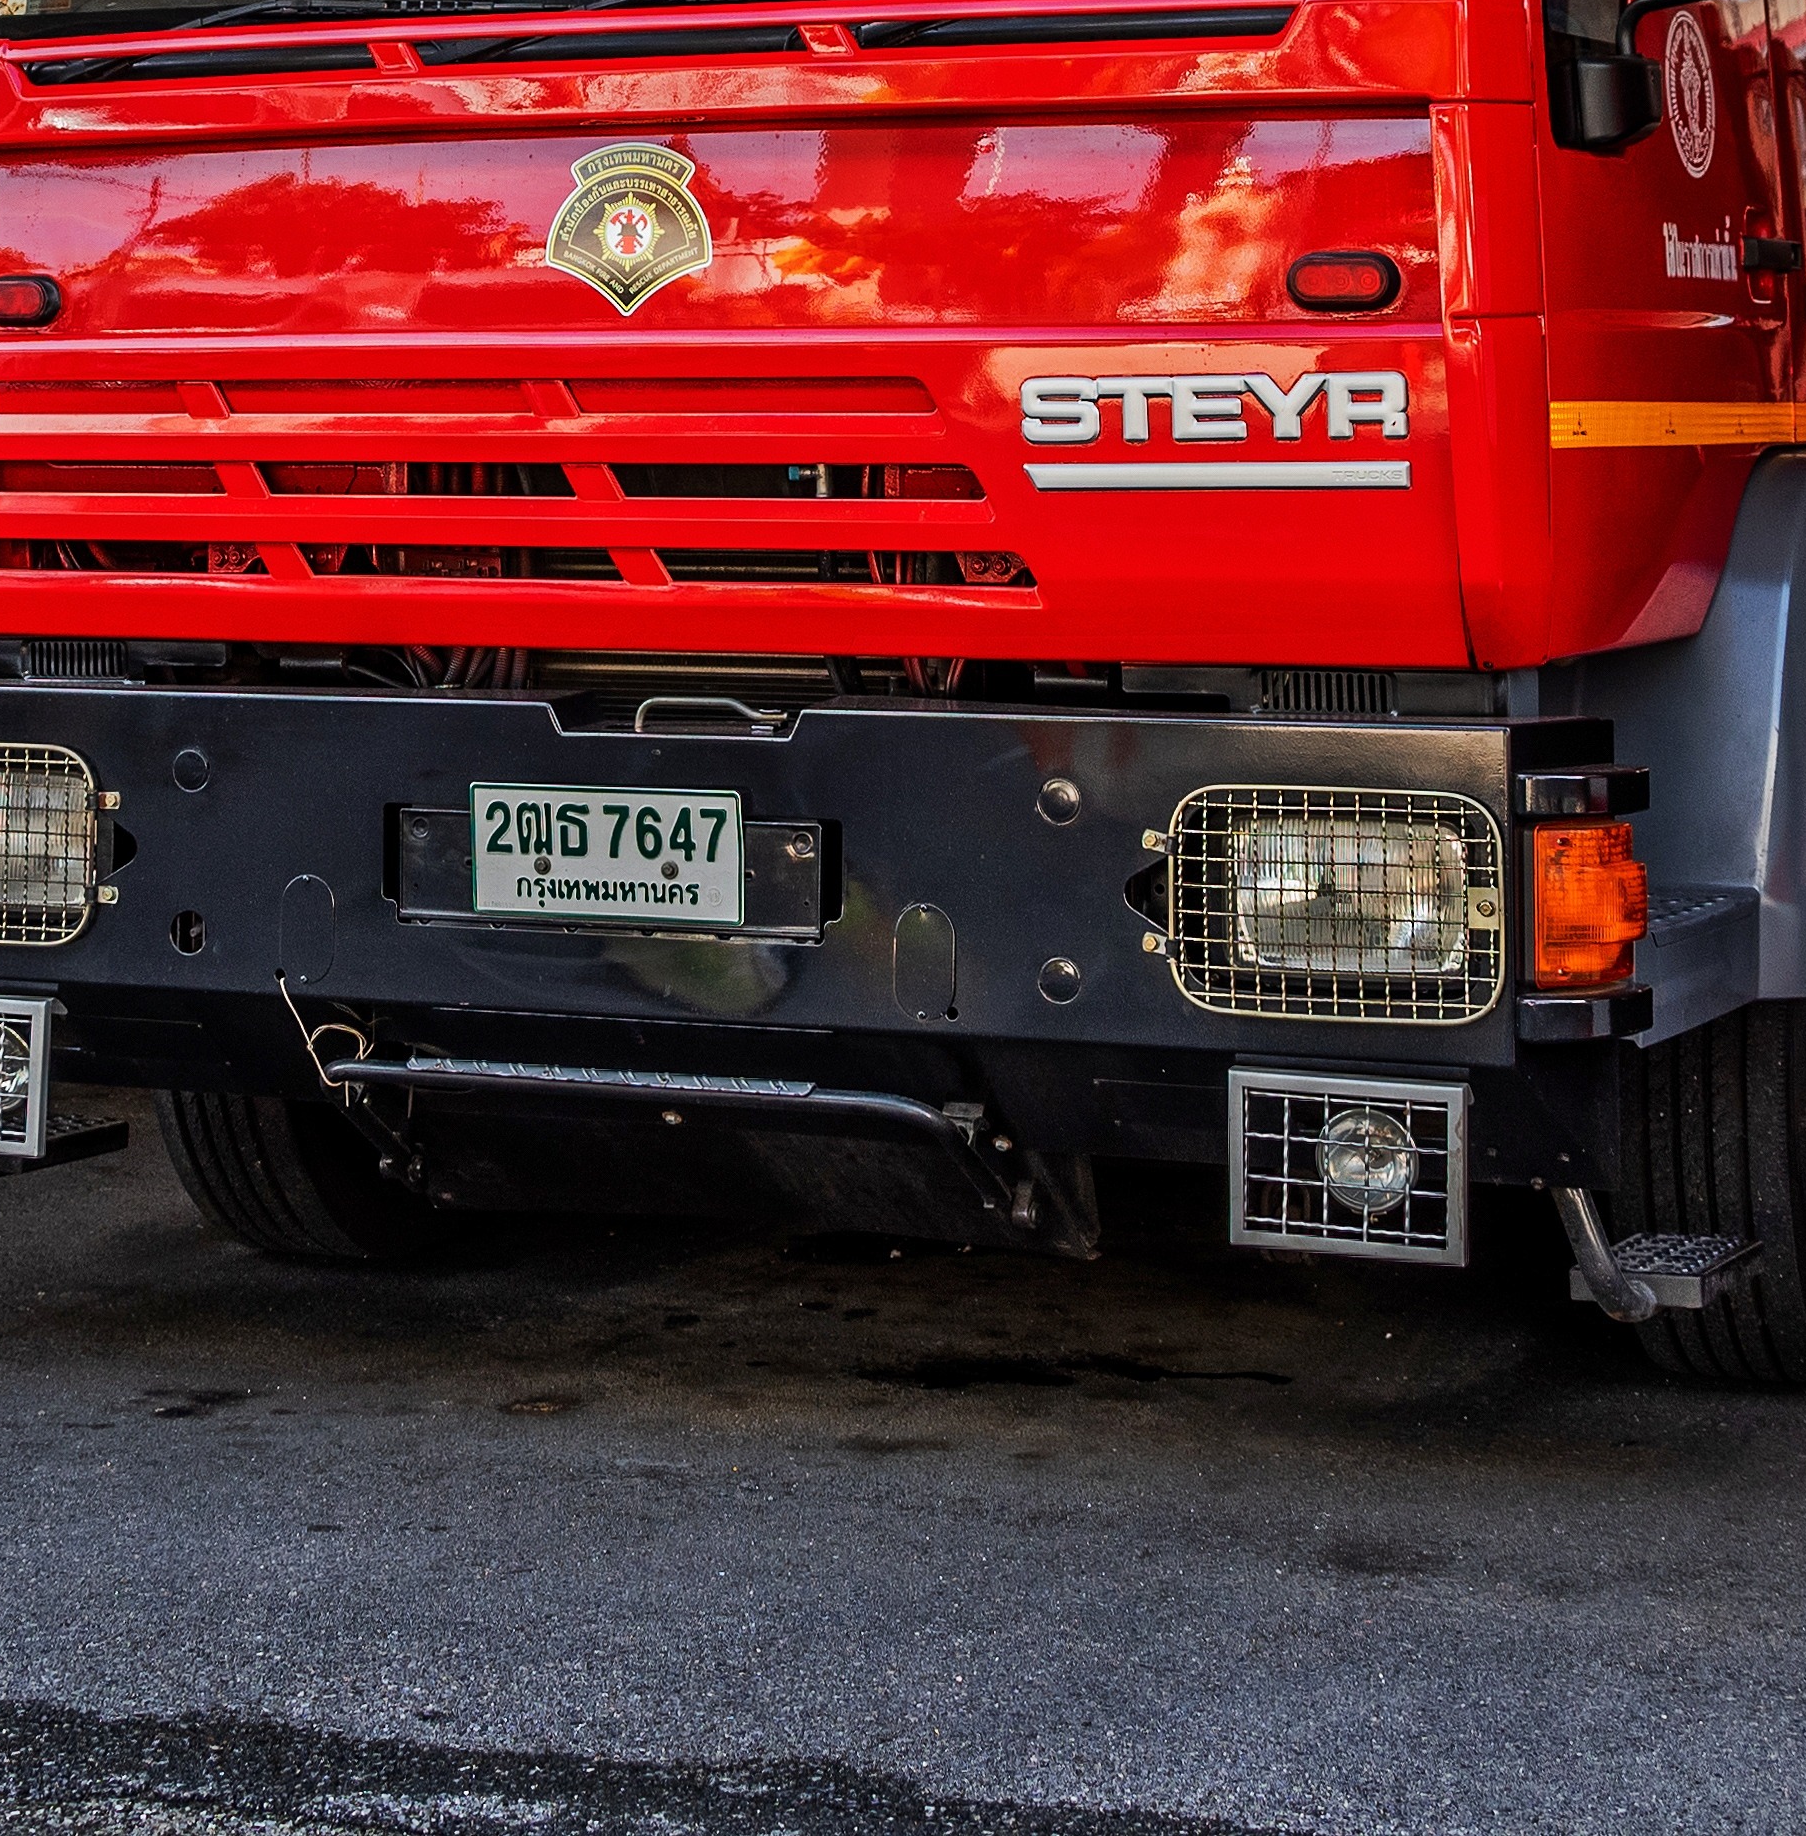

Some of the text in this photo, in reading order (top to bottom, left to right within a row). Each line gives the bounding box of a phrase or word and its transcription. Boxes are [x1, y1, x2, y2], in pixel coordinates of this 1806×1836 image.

[586, 150, 681, 175] กรุงเทพมหานคร
[562, 247, 700, 295] BANGKOK FIRE AND RESCUE DEPARTMENT
[1019, 370, 1410, 445] STEYR
[1331, 469, 1404, 482] TRUCKS
[602, 803, 728, 863] 7647
[515, 874, 700, 908] กรุงเทพมหานคร
